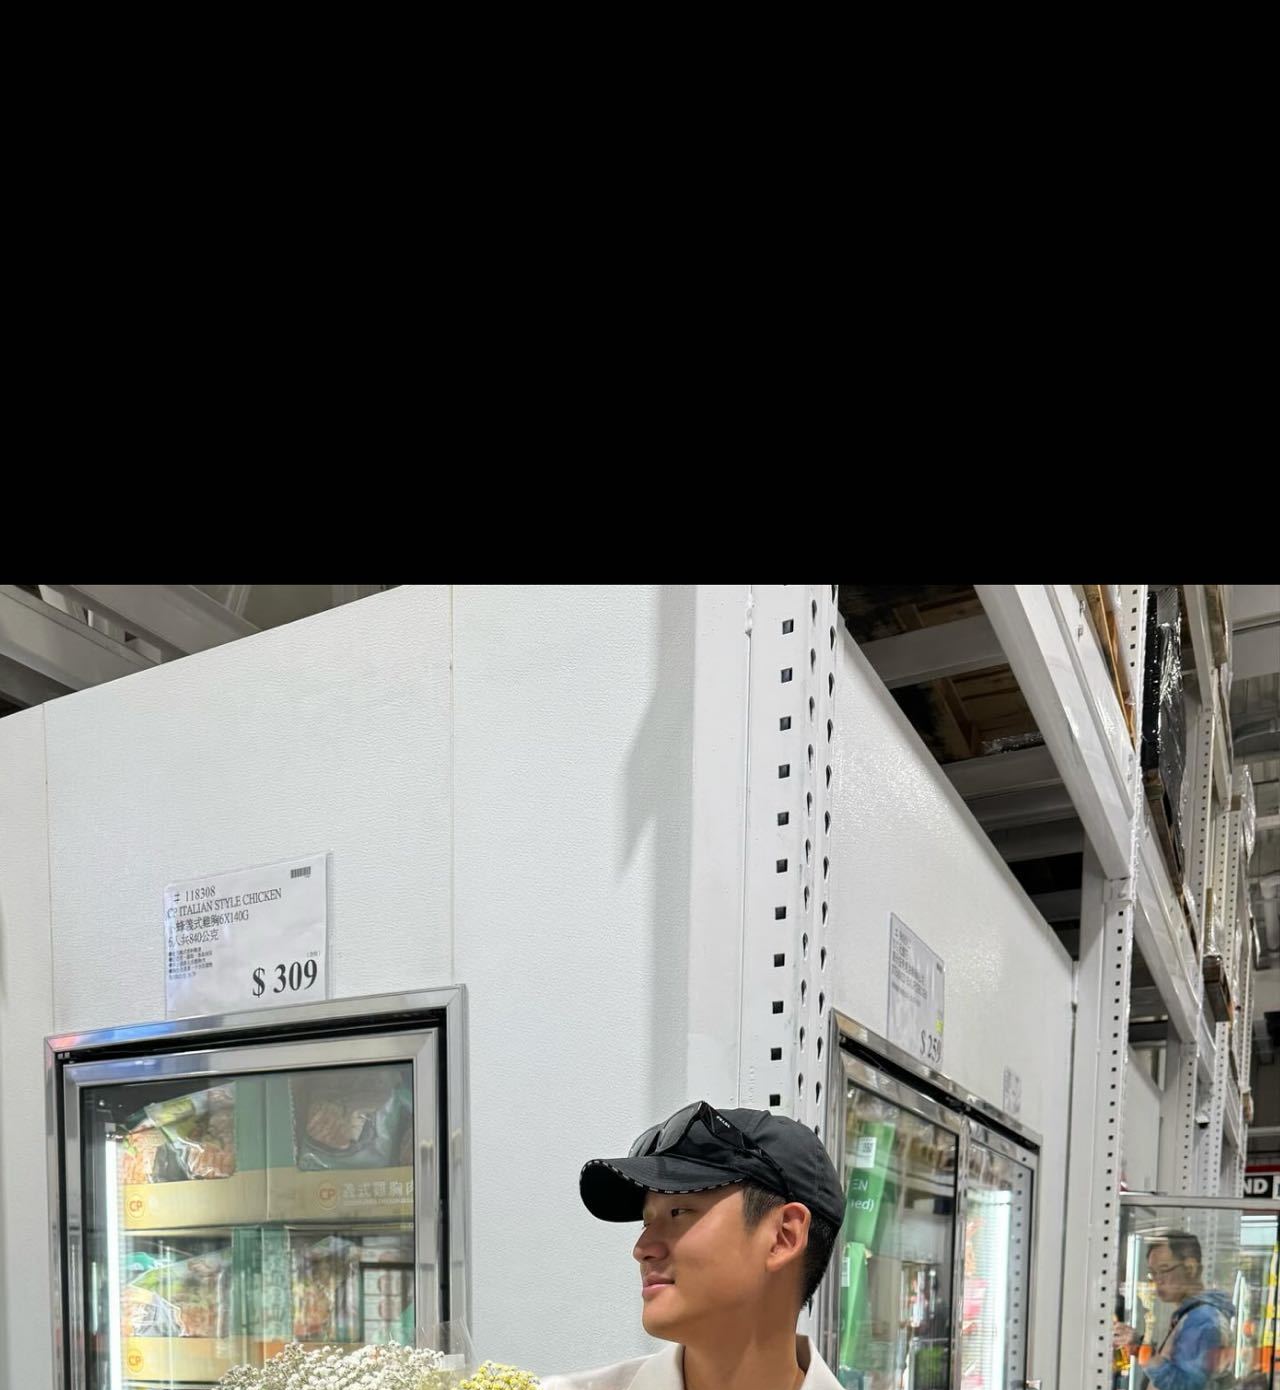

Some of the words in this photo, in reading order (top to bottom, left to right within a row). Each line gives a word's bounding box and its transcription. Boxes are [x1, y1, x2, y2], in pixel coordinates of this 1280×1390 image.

[179, 900, 213, 917] ITALIAN
[214, 895, 241, 911] STYLE
[242, 888, 283, 906] CHICKEN
[185, 886, 216, 902] 118308
[252, 967, 266, 998] $
[273, 959, 318, 994] 309
